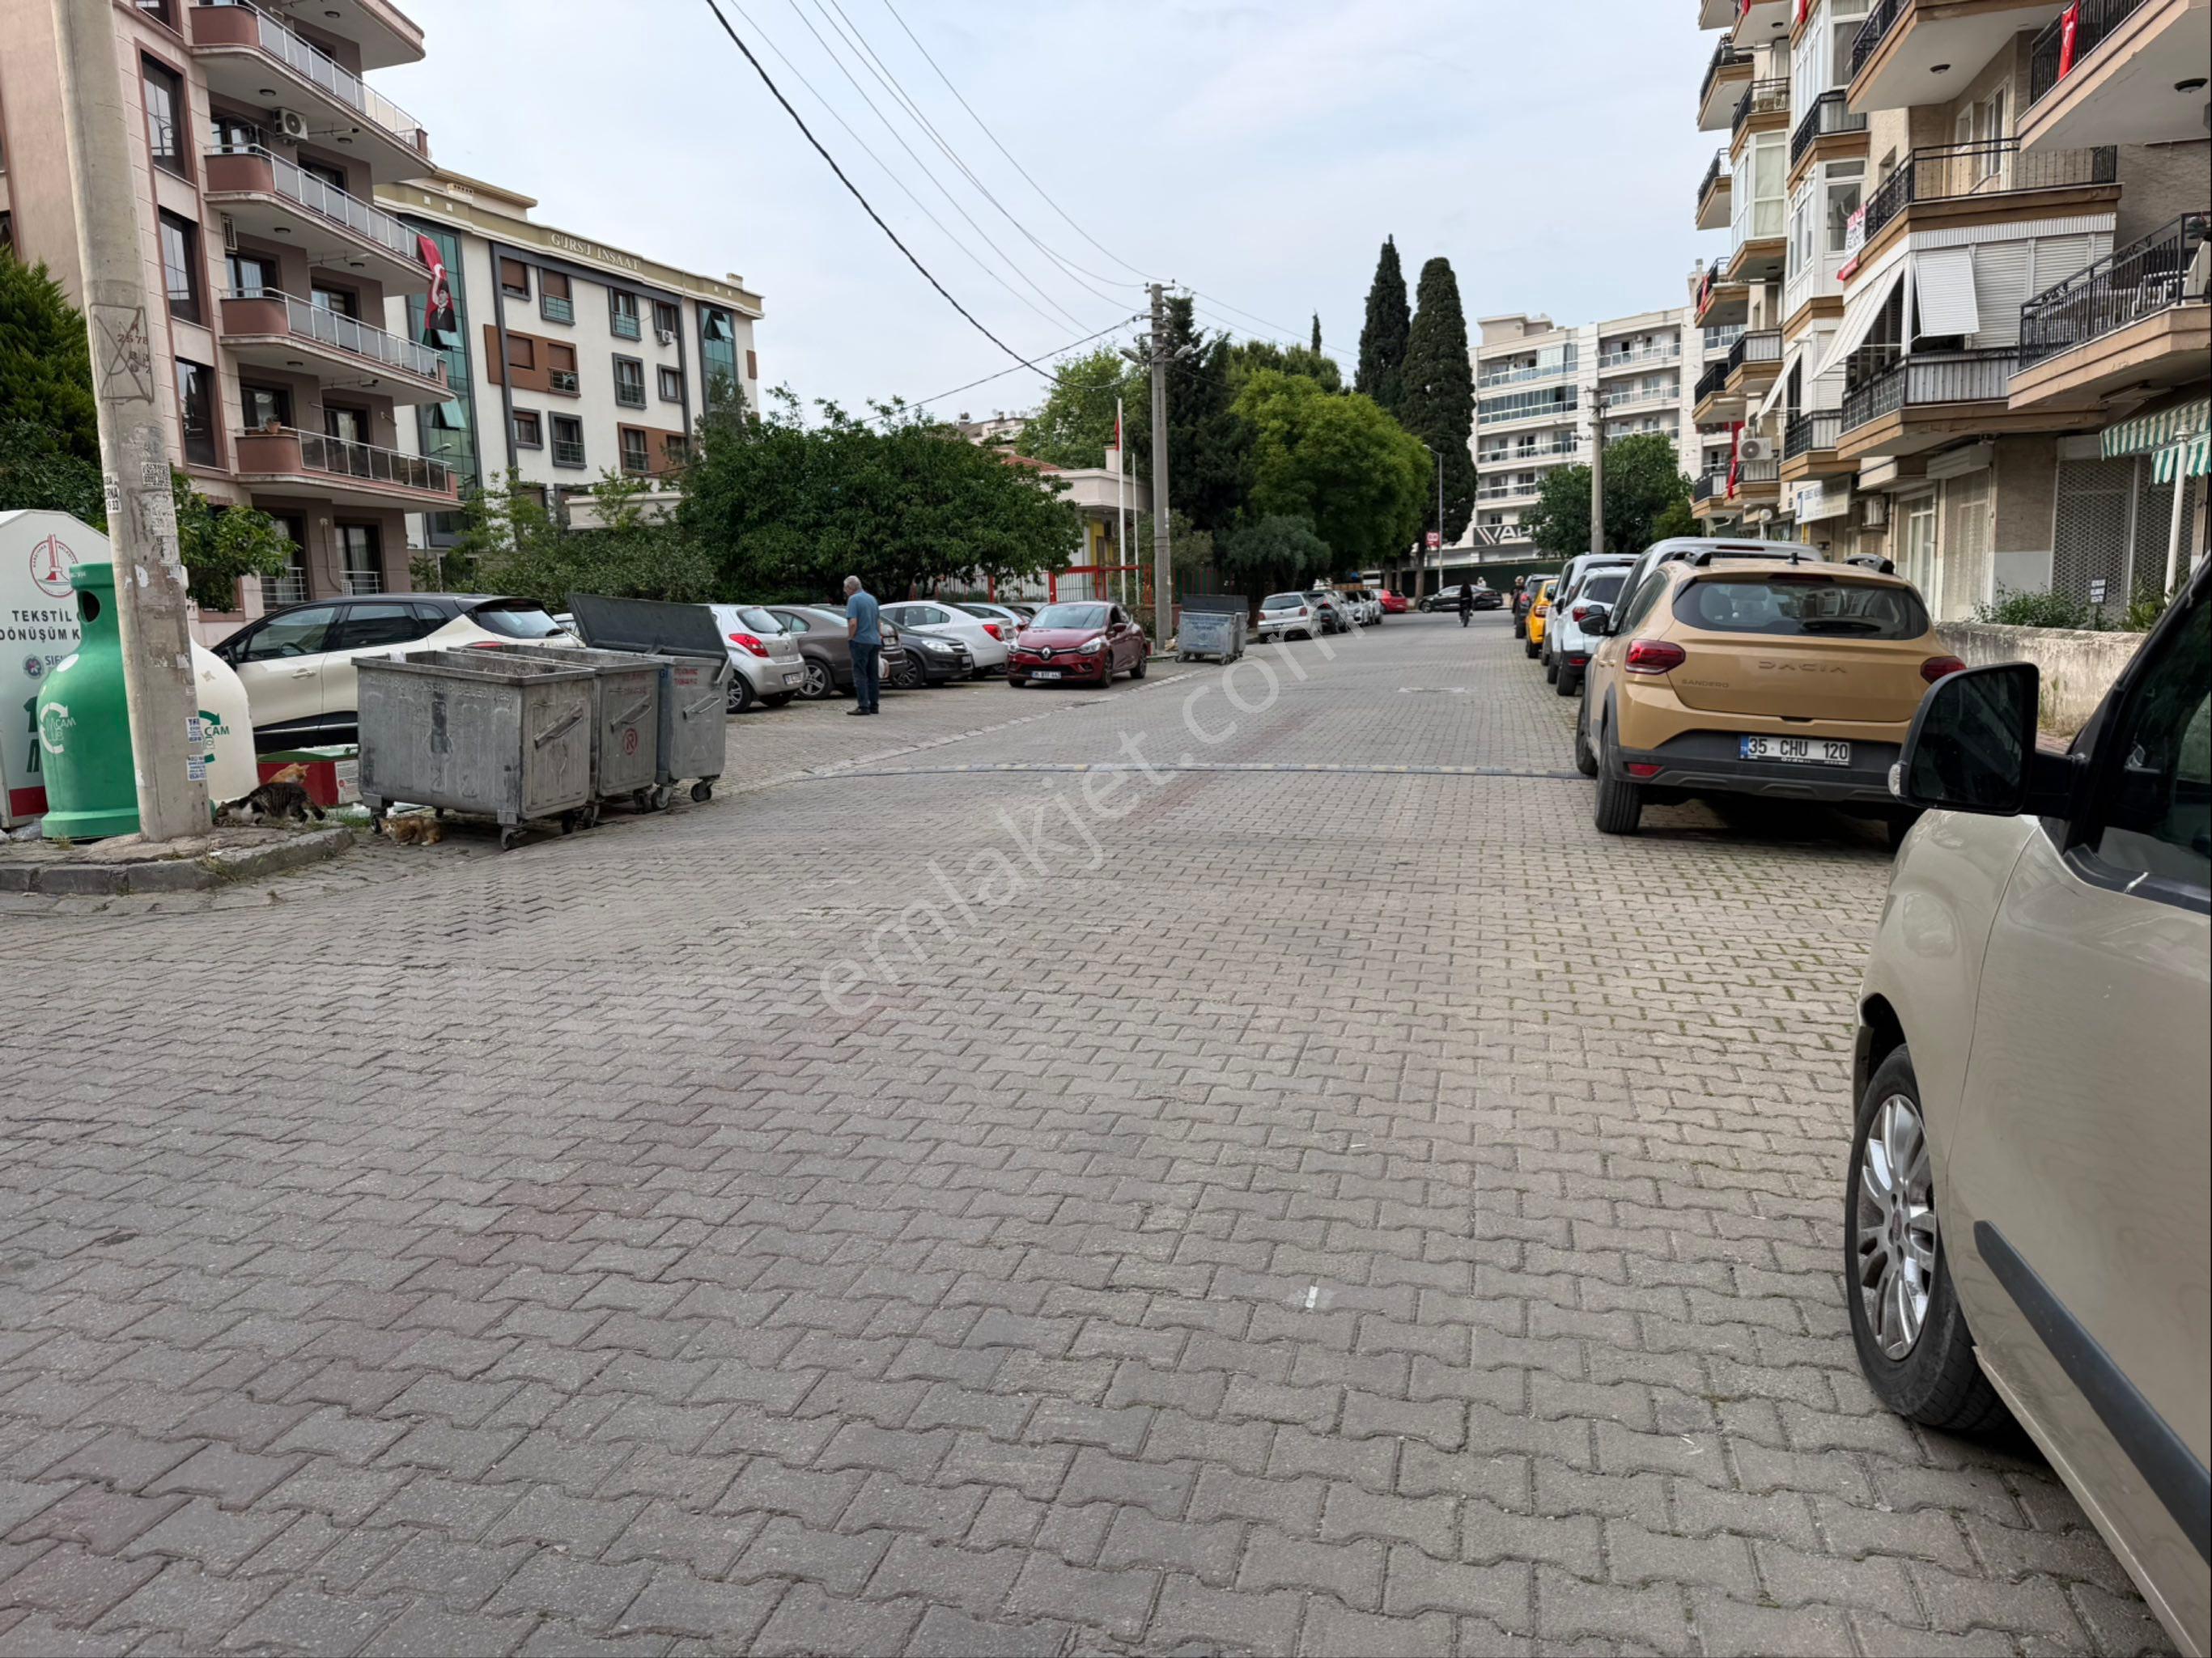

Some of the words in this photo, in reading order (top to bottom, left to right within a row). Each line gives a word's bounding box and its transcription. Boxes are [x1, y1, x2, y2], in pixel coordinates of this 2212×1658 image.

[12, 608, 73, 622] TEKSTİL
[0, 626, 68, 643] DÖNÜŞÜM
[1759, 661, 1848, 674] DACIA
[1681, 678, 1730, 688] SANDERO
[1749, 738, 1768, 754] 35
[1780, 740, 1809, 757] CHU
[1823, 742, 1849, 760] 120
